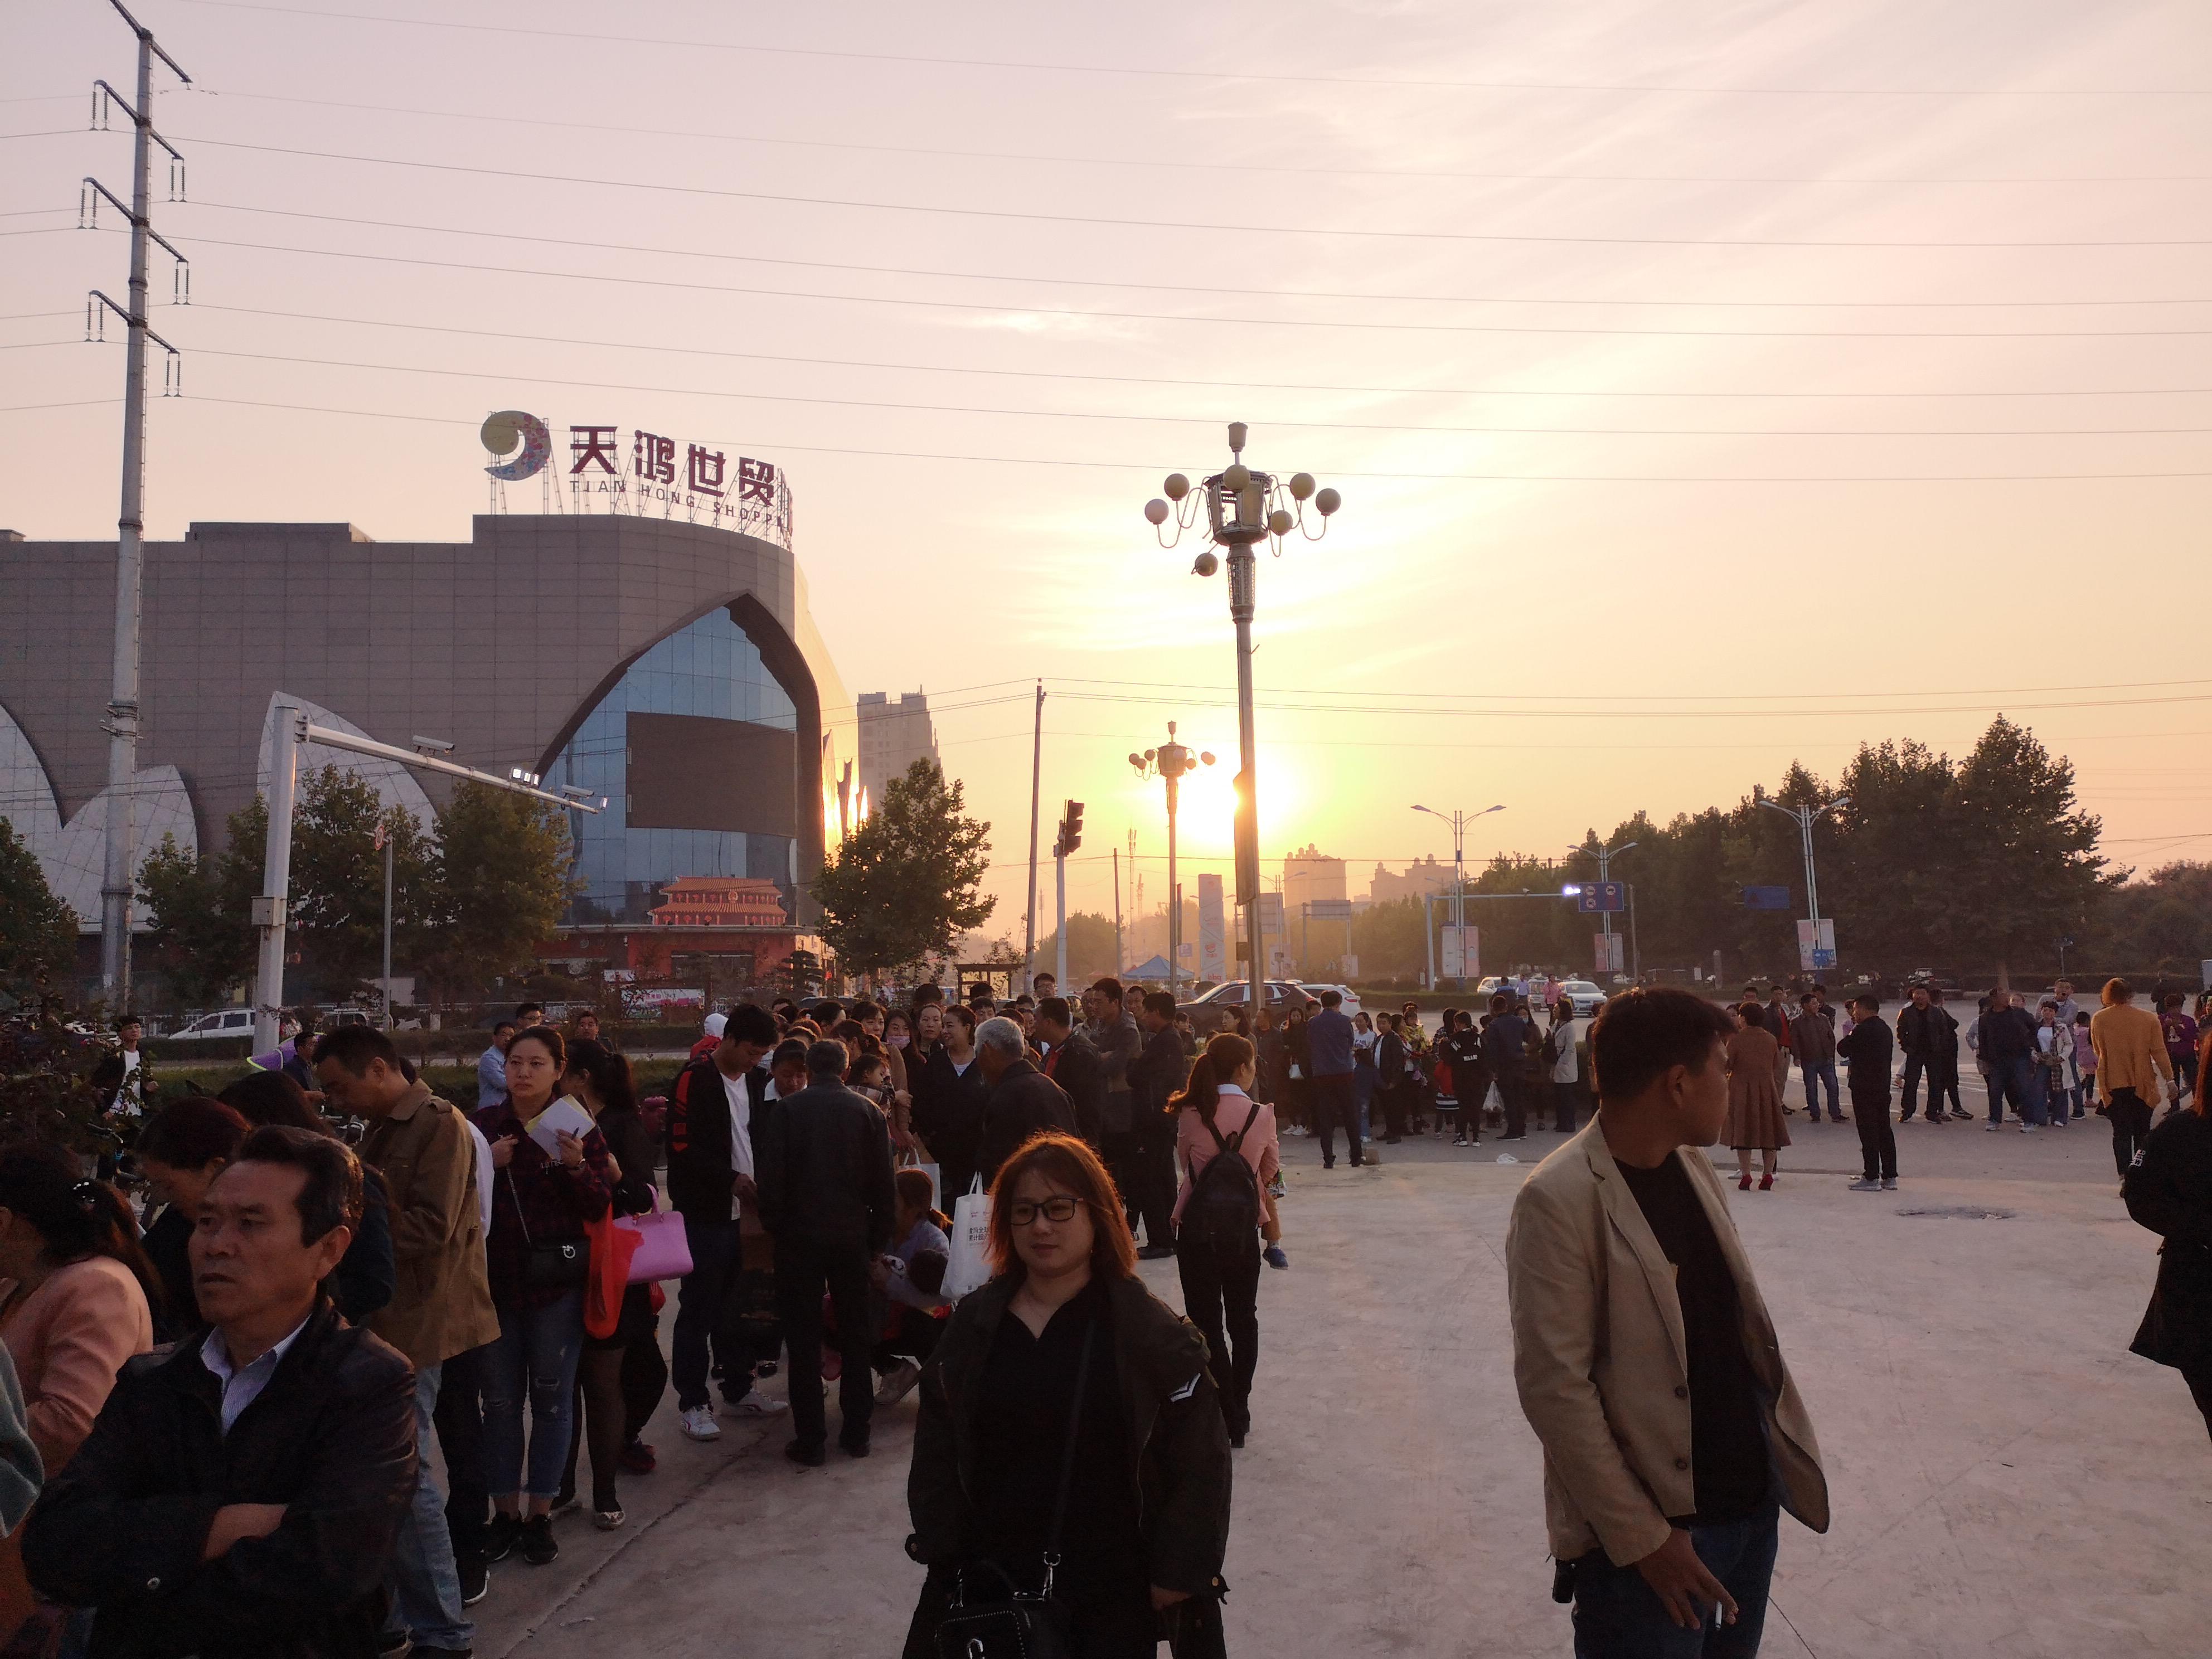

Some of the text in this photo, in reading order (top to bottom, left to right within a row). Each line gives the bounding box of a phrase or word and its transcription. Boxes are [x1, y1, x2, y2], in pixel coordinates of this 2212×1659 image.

[569, 425, 774, 507] 天鸿世贸
[569, 480, 625, 493] TIAN
[641, 483, 695, 507] HONG
[1181, 944, 1188, 953] P
